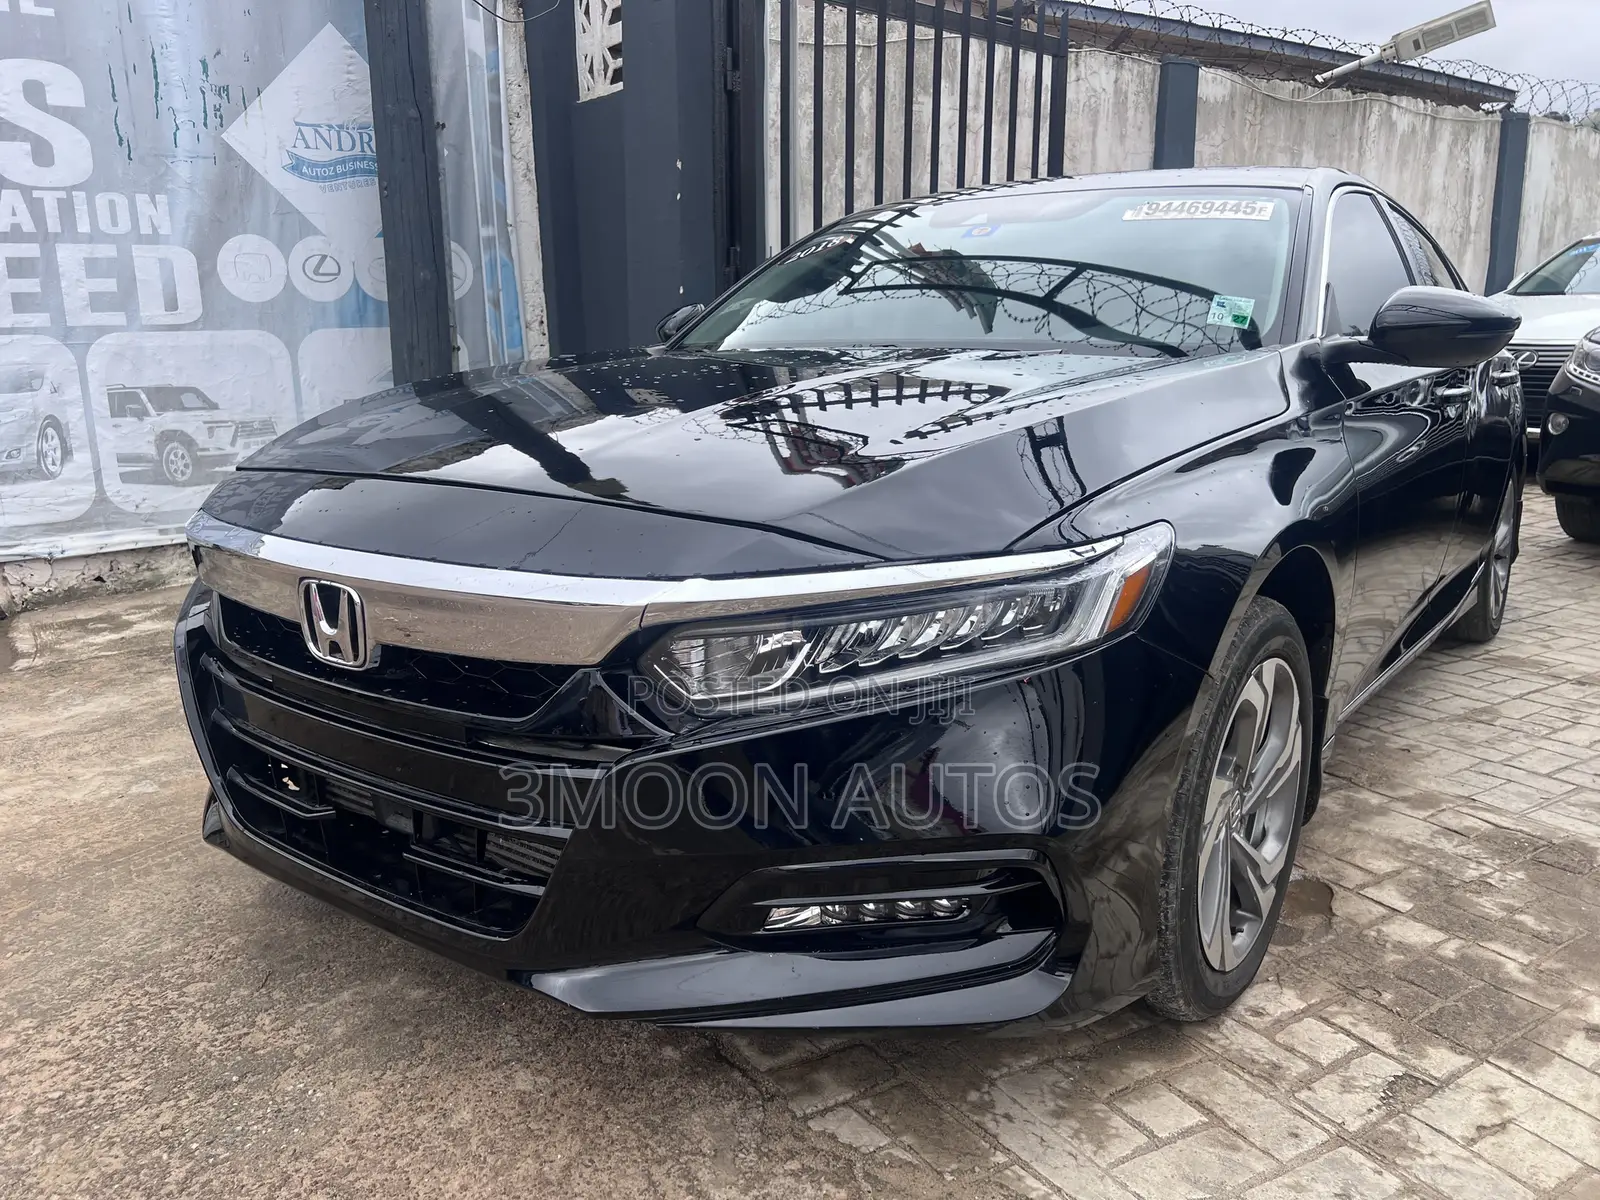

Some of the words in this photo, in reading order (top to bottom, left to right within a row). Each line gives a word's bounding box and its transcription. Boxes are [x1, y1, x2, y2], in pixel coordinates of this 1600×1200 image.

[302, 165, 335, 176] AUTOZ
[319, 178, 376, 194] VENTURES
[0, 189, 172, 235] ATION
[0, 243, 203, 328] EED
[1232, 315, 1248, 325] 27
